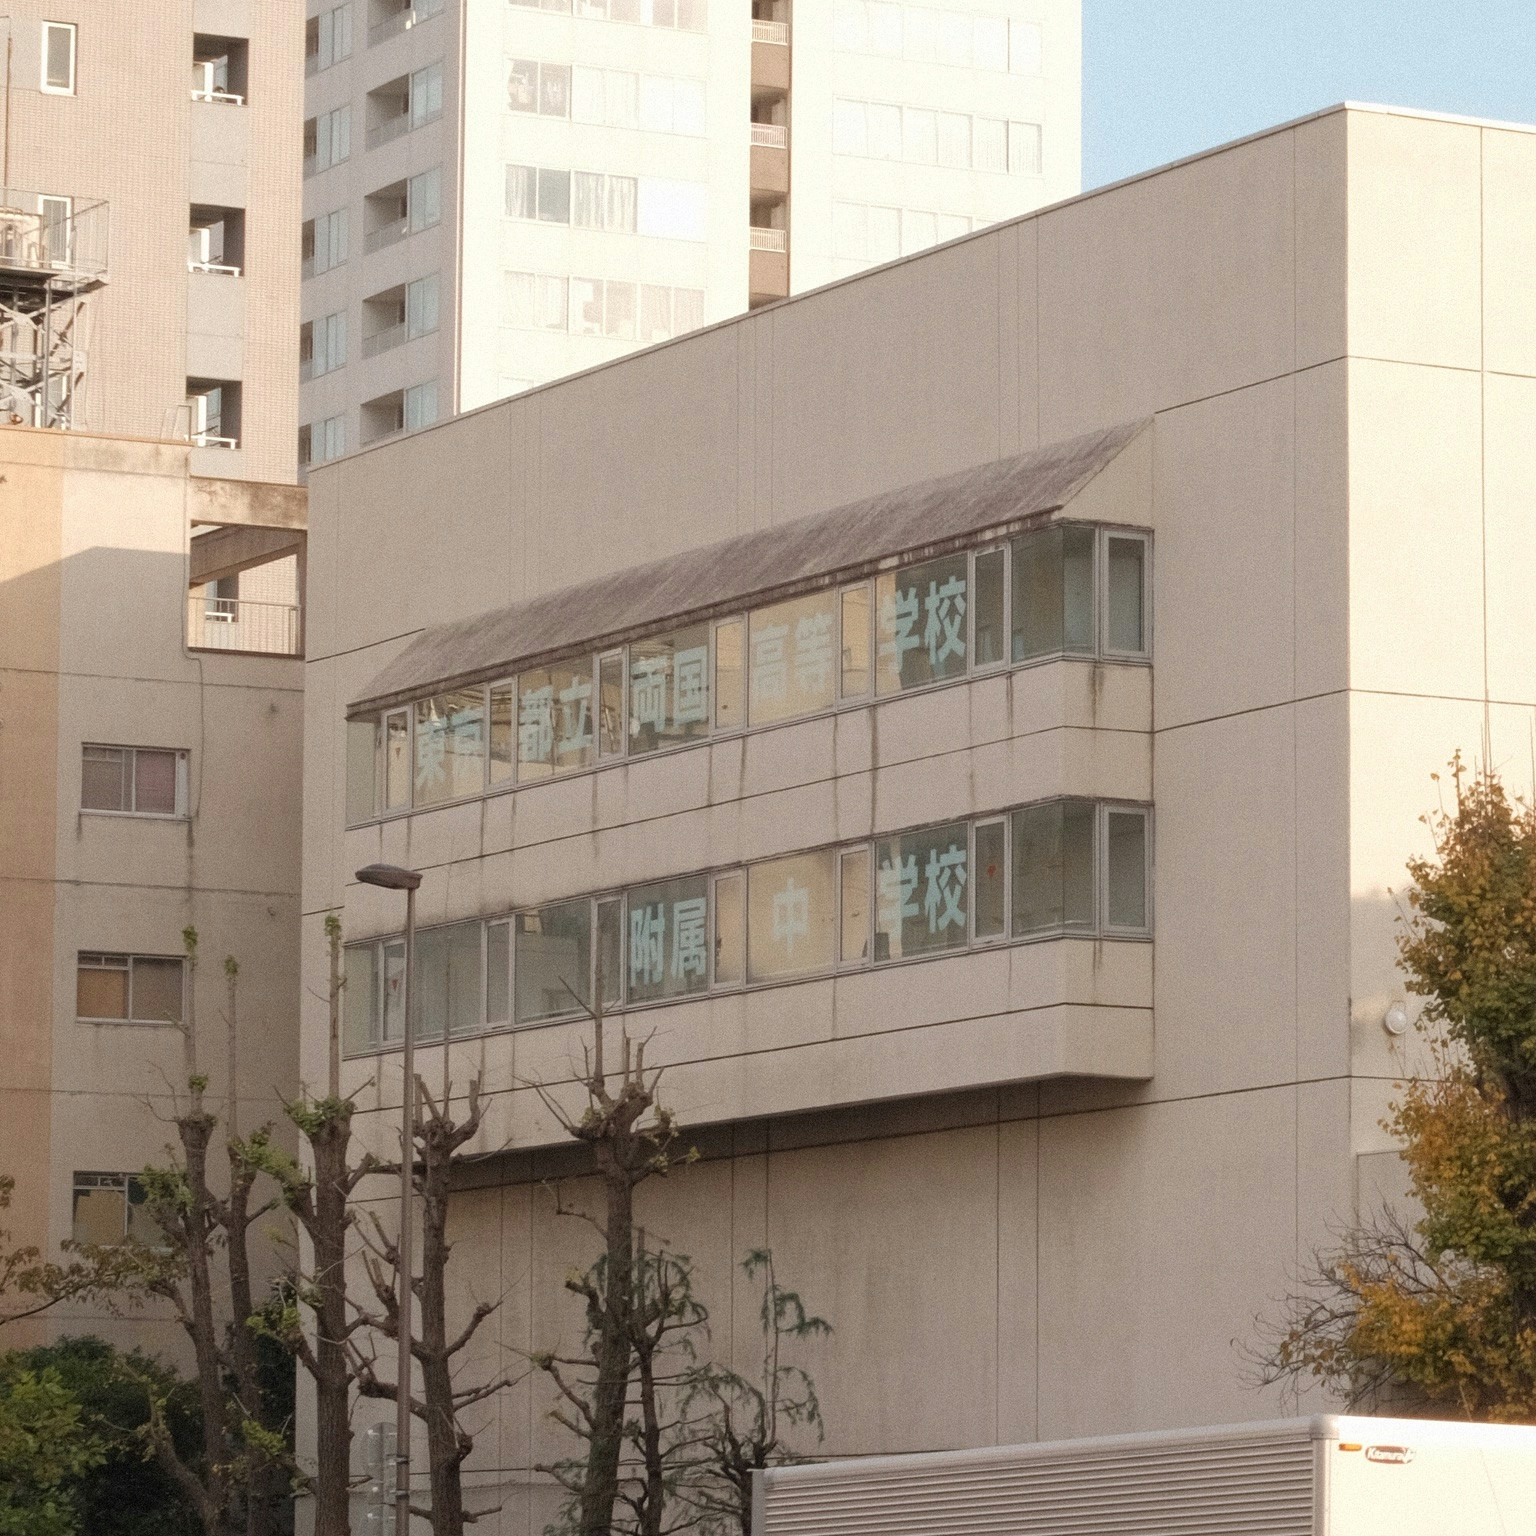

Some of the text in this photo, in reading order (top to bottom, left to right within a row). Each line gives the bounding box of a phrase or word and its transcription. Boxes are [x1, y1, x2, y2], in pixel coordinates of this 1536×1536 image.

[630, 843, 967, 988] 附属中学校
